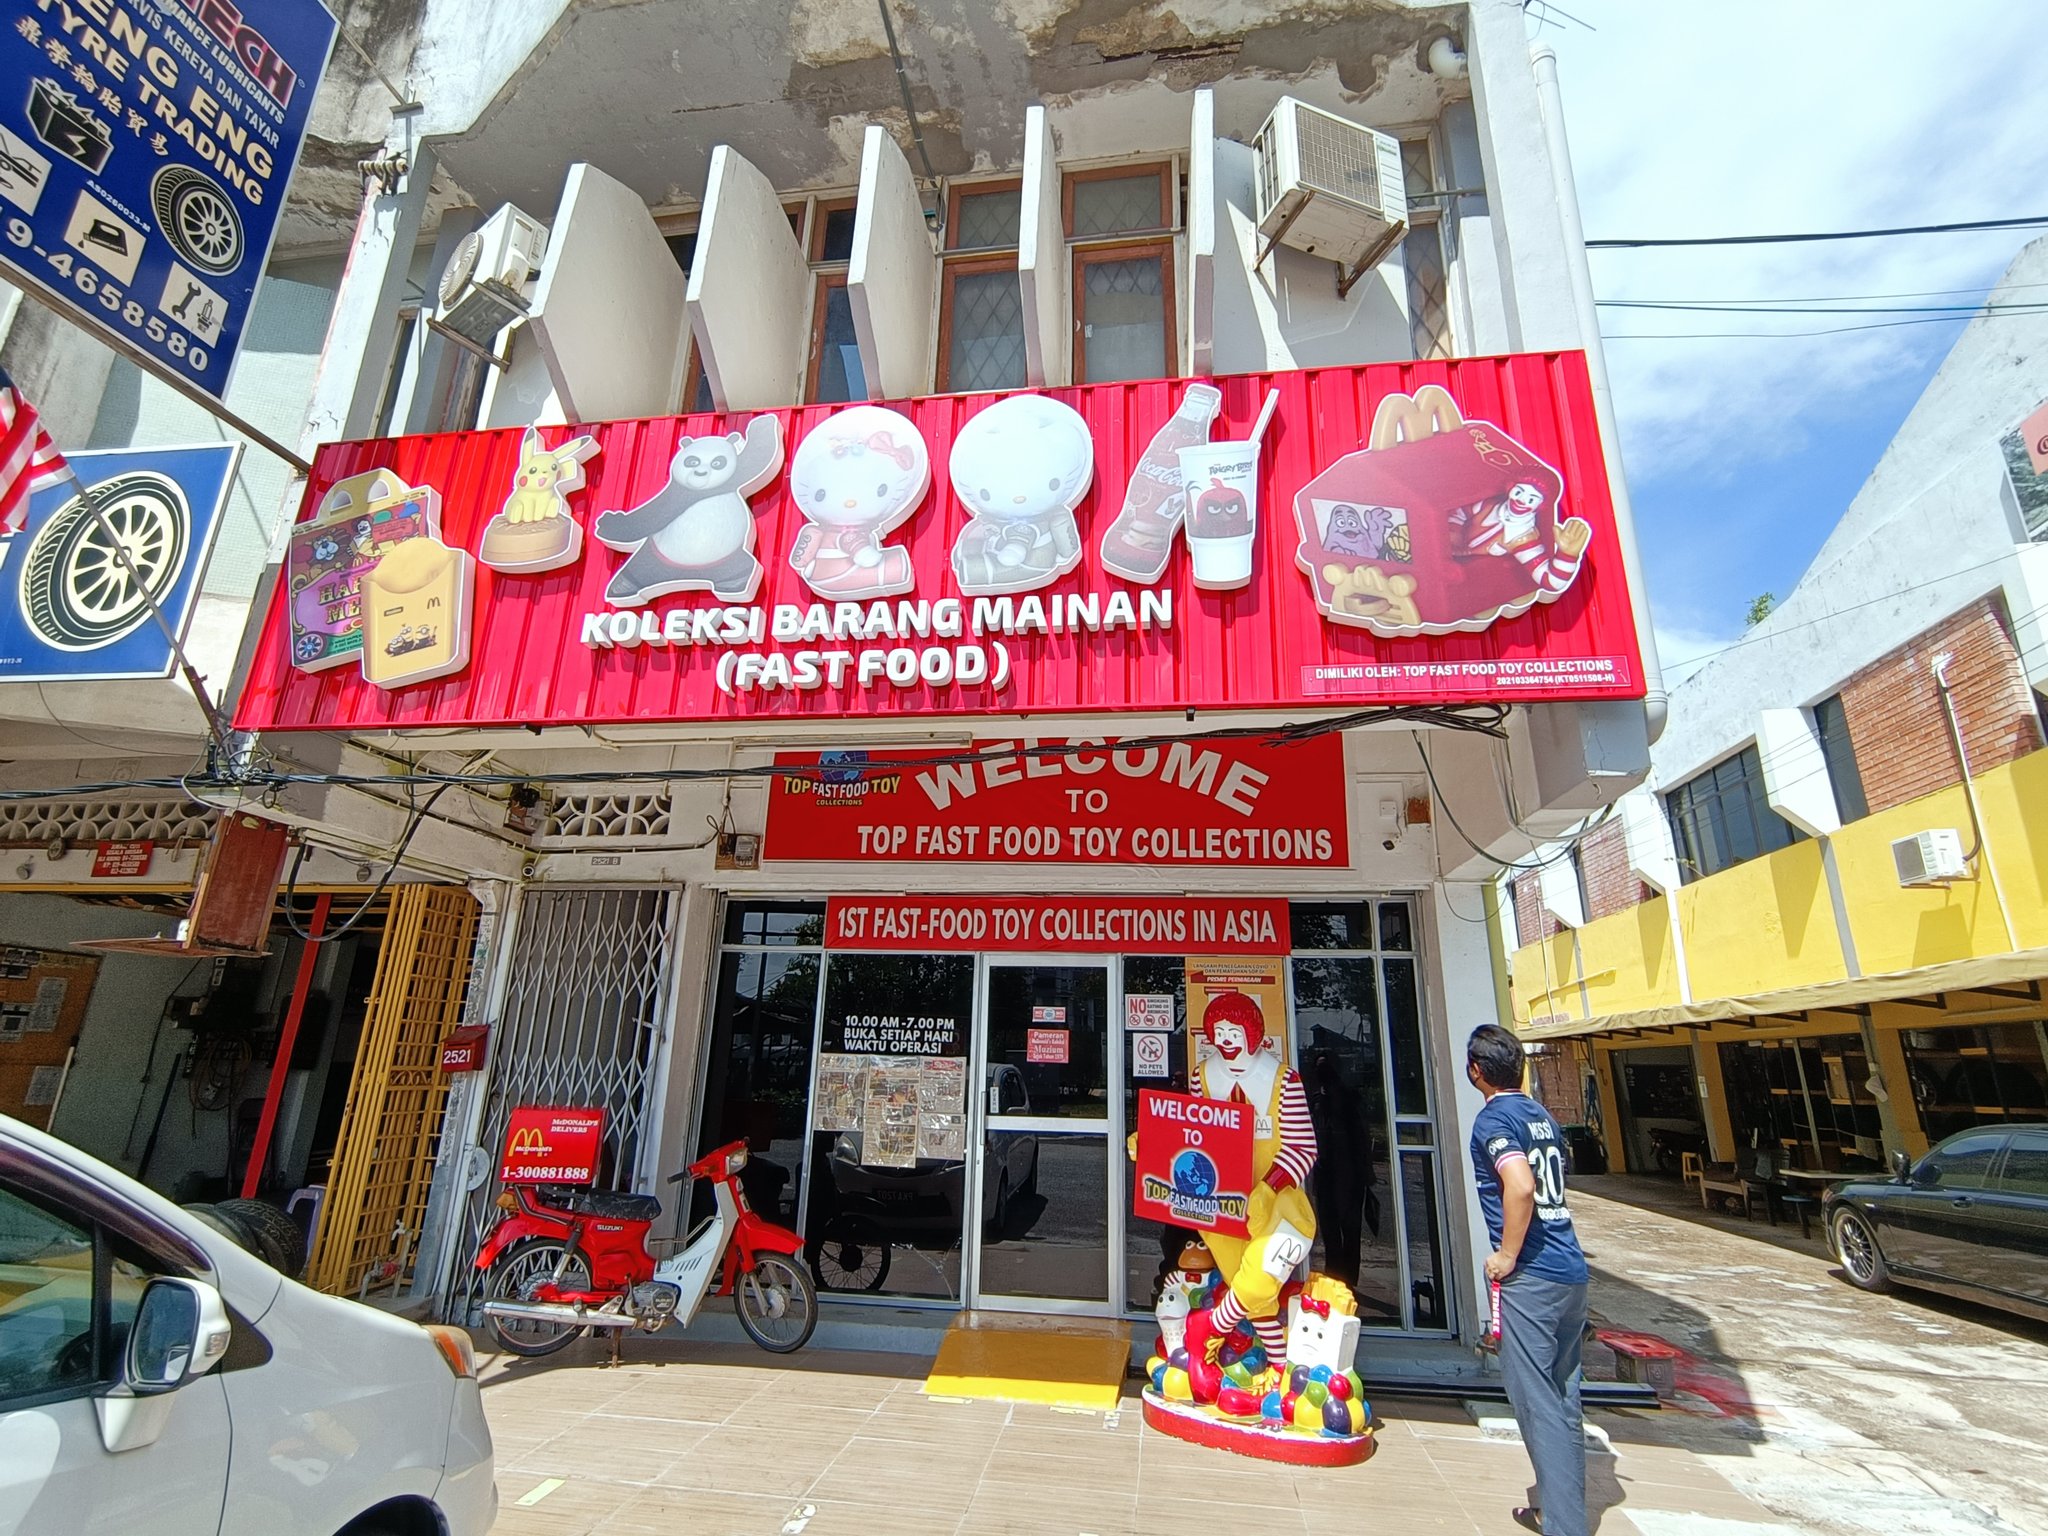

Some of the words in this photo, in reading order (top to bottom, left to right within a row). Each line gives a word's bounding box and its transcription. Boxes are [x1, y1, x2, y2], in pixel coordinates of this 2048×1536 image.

[164, 0, 211, 48] MANCE
[211, 44, 285, 125] LUBRICANTS
[164, 25, 215, 85] KERETA
[216, 78, 243, 111] DAN
[244, 105, 280, 149] TAYAR
[138, 74, 262, 205] TRADING
[189, 85, 274, 180] ENG
[0, 207, 208, 371] 9-4658580
[580, 605, 763, 648] KOLEKSI
[771, 597, 961, 640] BARANG
[971, 589, 1174, 634] MAINAN
[714, 648, 855, 696] (FAST
[858, 641, 1010, 690] FOOD)
[1315, 666, 1363, 679] DIMILIKI
[1365, 665, 1402, 678] OLEH:
[1403, 664, 1428, 677] TOP
[1429, 664, 1460, 676] FAST
[1462, 662, 1496, 675] FOOD
[1498, 661, 1523, 674] TOY
[1525, 659, 1613, 673] COLLECTIONS
[783, 776, 811, 794] TOP
[812, 782, 838, 798] FAST
[840, 781, 869, 798] FOOD
[871, 776, 901, 794] TOY
[915, 736, 1270, 817] WELCOME
[1065, 788, 1109, 814] TO
[857, 825, 907, 855] TOP
[916, 825, 979, 856] FAST
[987, 826, 1061, 857] FOOD
[1069, 826, 1123, 857] TOY
[1131, 827, 1333, 860] COLLECTIONS
[592, 857, 610, 865] 2521
[838, 907, 869, 938] 1ST
[873, 906, 988, 940] FAST-FOOD
[992, 908, 1035, 940] TOY
[1039, 908, 1185, 941] COLLECTIONS
[1193, 909, 1216, 942] IN
[1223, 909, 1277, 943] ASIA
[1130, 998, 1147, 1014] NO
[844, 1028, 877, 1040] BUKA
[880, 1029, 921, 1041] SETIAP
[924, 1030, 953, 1042] HARI
[845, 1015, 878, 1028] 10.00
[880, 1016, 900, 1028] AM
[936, 1018, 955, 1030] PM
[1033, 1031, 1064, 1039] Pameran
[443, 1049, 471, 1064] 2521
[844, 1039, 887, 1052] WAKTU
[890, 1040, 942, 1054] OPERASI
[551, 1118, 599, 1127] McDONALD'S
[1149, 1096, 1241, 1130] WELCOME
[1182, 1128, 1203, 1146] TO
[502, 1165, 589, 1180] 1-300881888
[1528, 1146, 1565, 1206] 30
[1145, 1179, 1170, 1201] TOP
[1169, 1191, 1193, 1211] FAST
[1193, 1198, 1218, 1213] FOOD
[1220, 1198, 1245, 1217] TOY
[1173, 1208, 1214, 1222] COLLECTIONS
